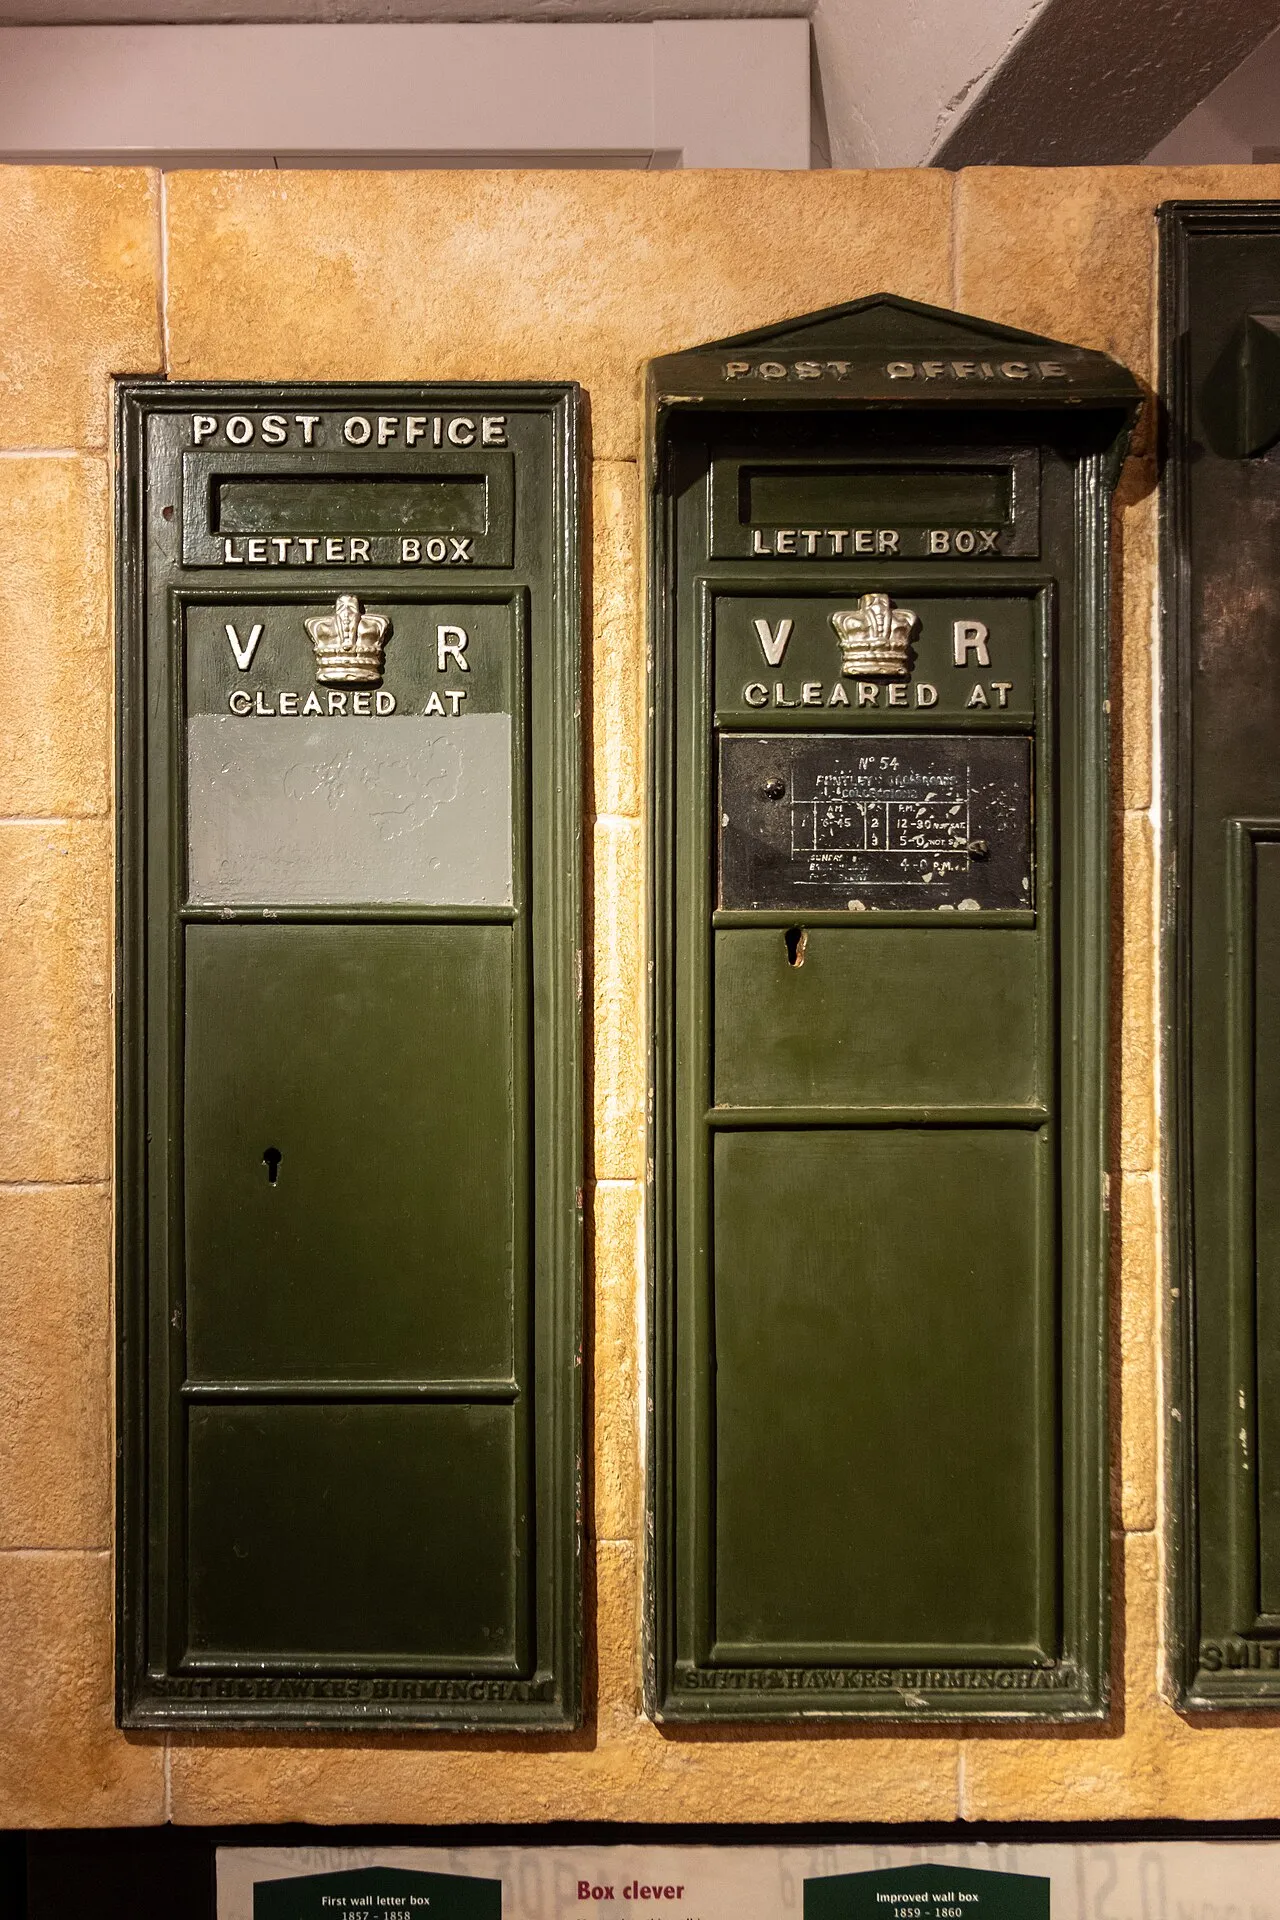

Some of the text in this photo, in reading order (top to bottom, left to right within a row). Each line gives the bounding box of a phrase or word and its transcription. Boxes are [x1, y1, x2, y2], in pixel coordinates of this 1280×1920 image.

[723, 360, 1069, 382] POST OFFICE
[192, 414, 508, 447] POST OFFICE
[223, 537, 474, 564] LETTER BOX
[751, 529, 1002, 555] LETTER BOX
[224, 624, 471, 672] V R
[753, 618, 992, 667] V R
[228, 690, 467, 717] CLEARED AT
[743, 681, 1013, 708] CLEARED AT
[879, 756, 900, 771] 54
[870, 818, 880, 829] 2
[870, 836, 879, 846] 3
[899, 1670, 1075, 1689] BIRMINGHAM
[373, 1680, 548, 1700] BIRMINGHAM
[577, 1880, 685, 1900] Box clever
[876, 1892, 980, 1904] Improved wall box
[321, 1895, 430, 1906] First wall letter box
[342, 1911, 369, 1920] 1857
[384, 1911, 411, 1920] 1858
[894, 1908, 921, 1918] 1859
[935, 1908, 962, 1918] 1860
